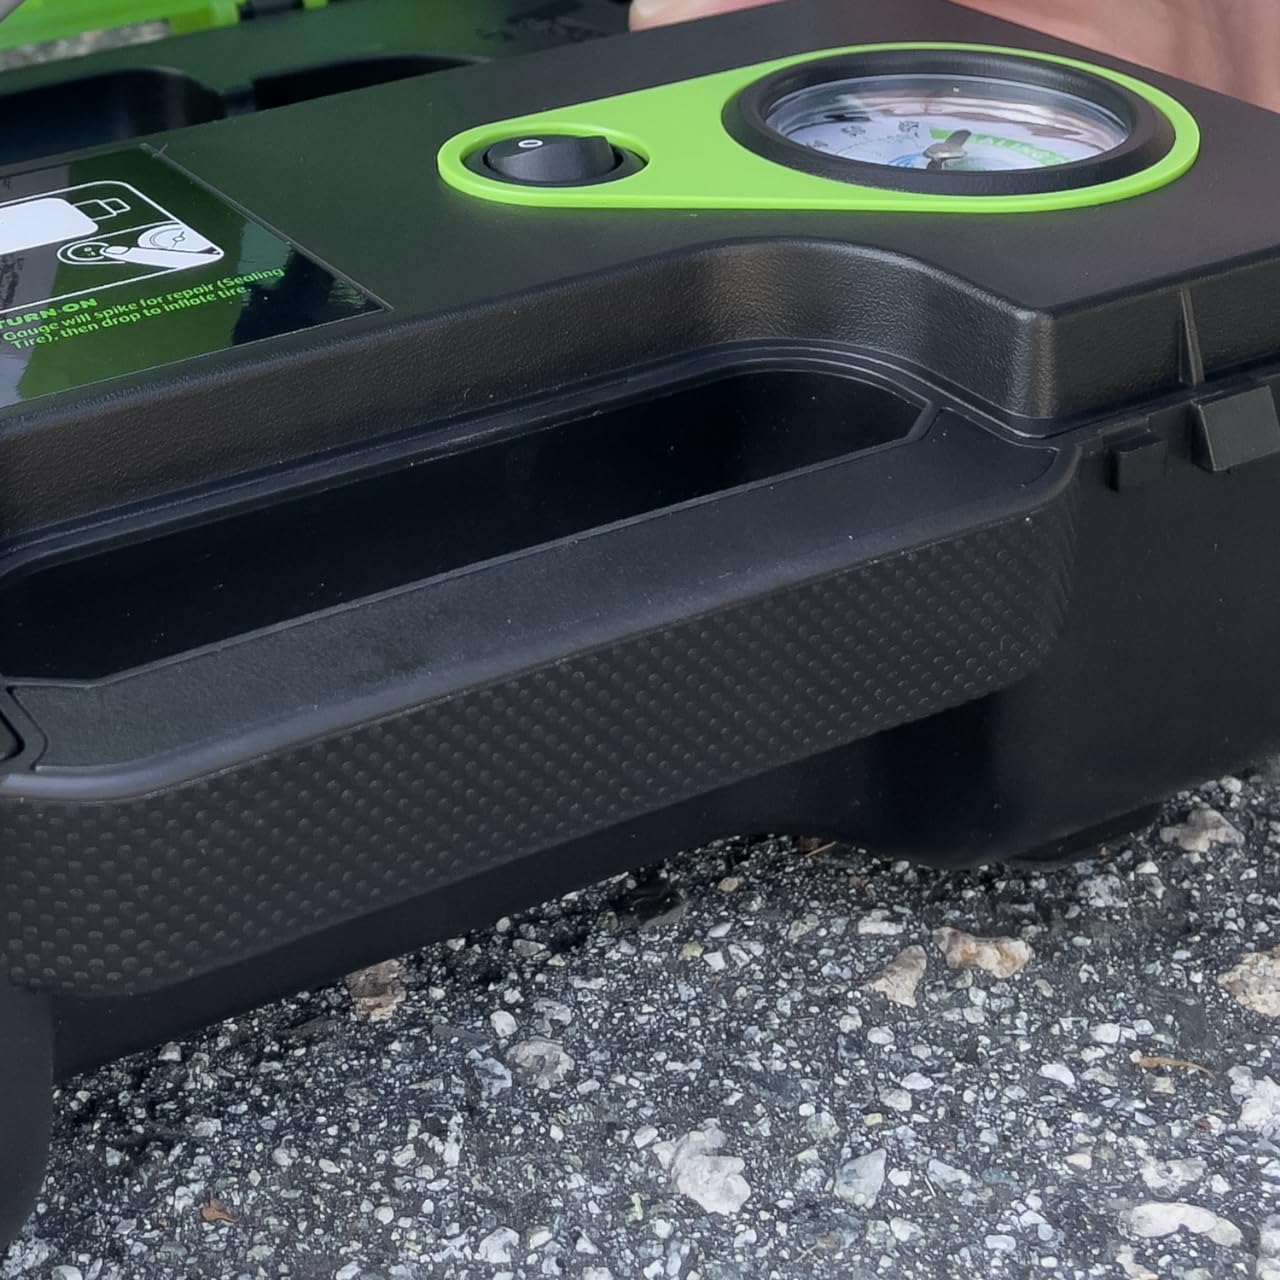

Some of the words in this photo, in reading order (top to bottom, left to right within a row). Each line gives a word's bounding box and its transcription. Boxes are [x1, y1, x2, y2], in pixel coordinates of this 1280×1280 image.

[2, 322, 59, 342] Gauge
[60, 312, 91, 326] will
[93, 302, 138, 319] spike
[138, 295, 163, 307] for
[166, 283, 214, 302] repair
[216, 267, 285, 290] (Sealing
[9, 330, 59, 349] Tire),
[60, 322, 99, 337] then
[100, 311, 141, 327] drop
[143, 307, 161, 316] to
[161, 293, 217, 312] inflate
[216, 285, 251, 298] tire.
[61, 297, 97, 312] ON
